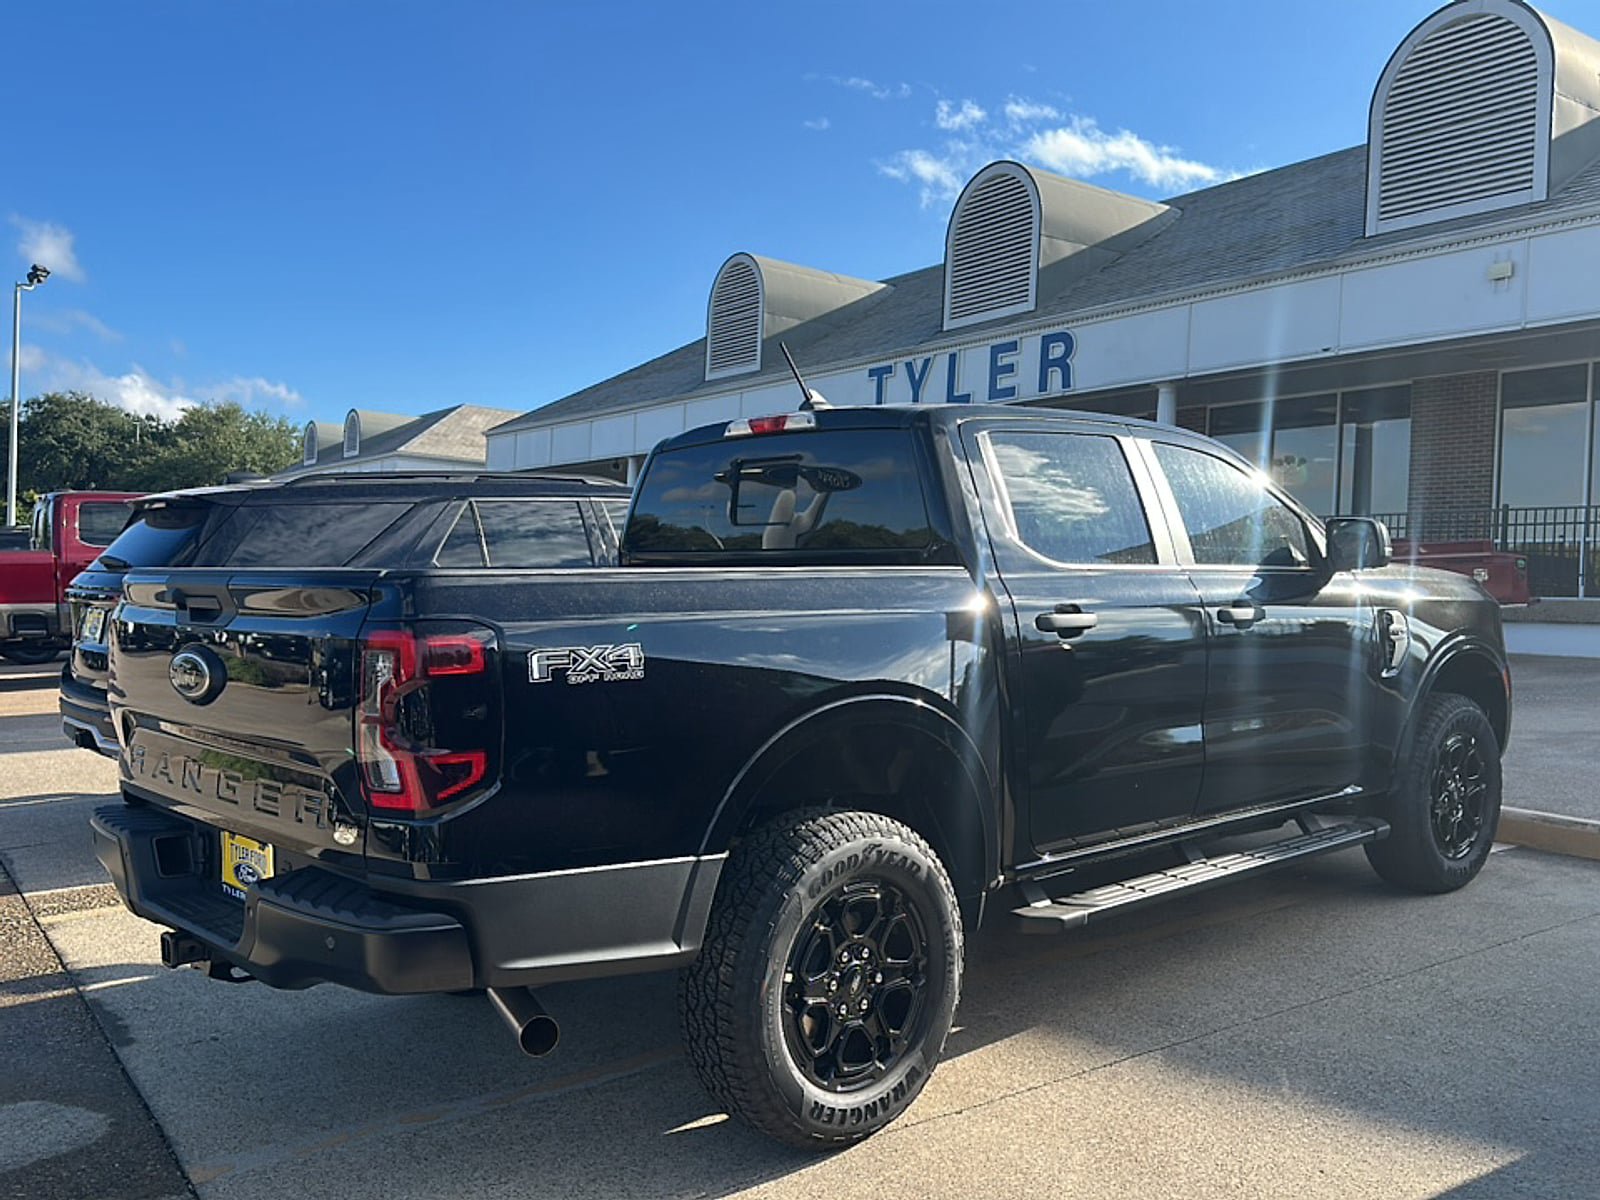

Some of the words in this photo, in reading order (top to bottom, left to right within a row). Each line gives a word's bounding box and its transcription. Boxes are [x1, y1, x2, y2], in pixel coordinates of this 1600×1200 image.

[867, 330, 1077, 405] TYLER
[527, 643, 644, 682] FX4
[130, 745, 330, 829] RANGER
[808, 843, 922, 898] GOODYEAR
